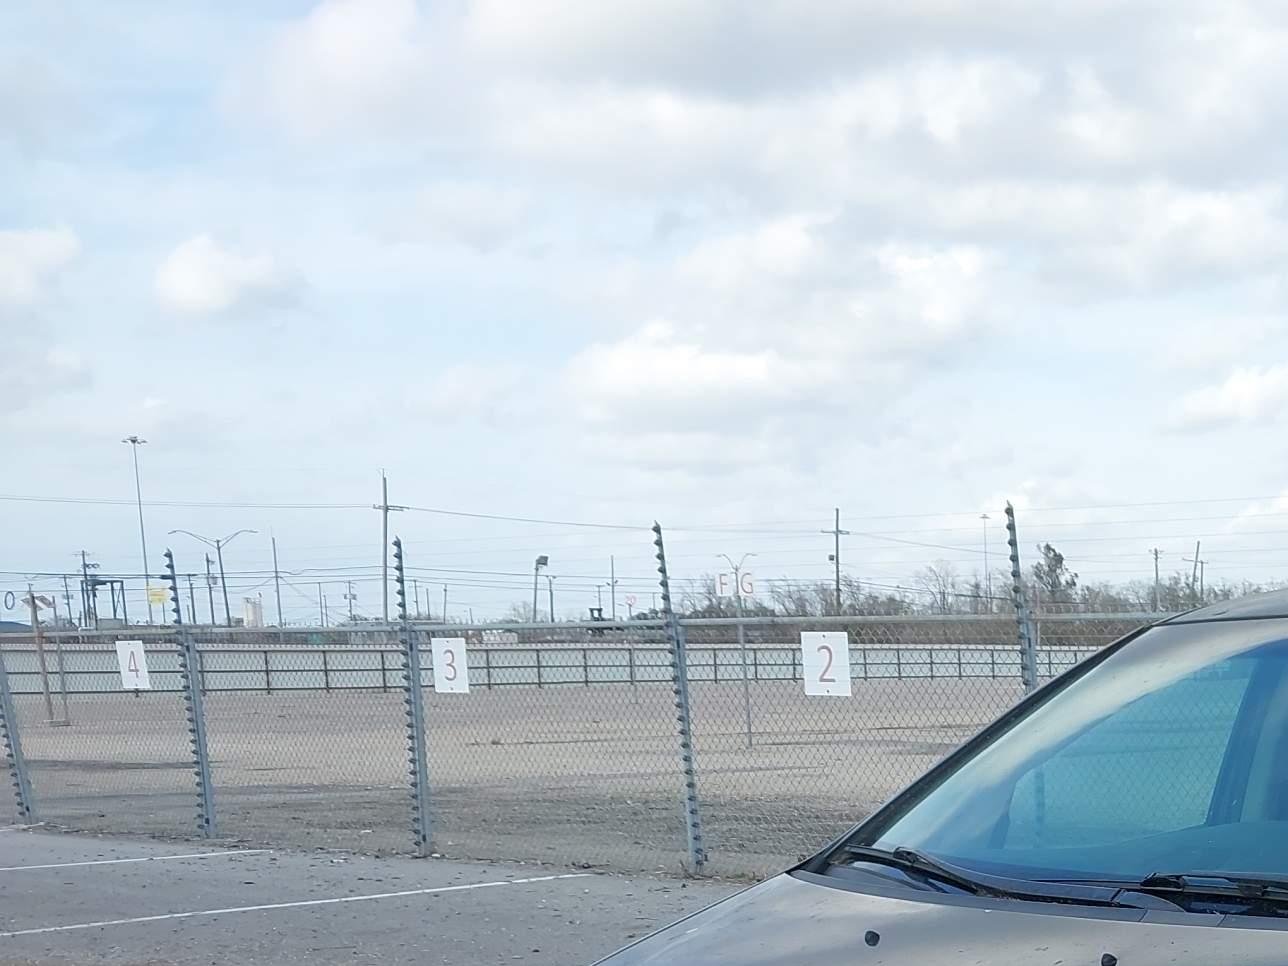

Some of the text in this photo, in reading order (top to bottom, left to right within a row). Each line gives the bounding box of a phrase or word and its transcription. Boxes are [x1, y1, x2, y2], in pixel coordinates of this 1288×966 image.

[719, 573, 729, 595] F
[741, 572, 754, 594] G
[128, 650, 140, 679] 4
[443, 648, 457, 682] 3
[816, 644, 837, 684] 2
